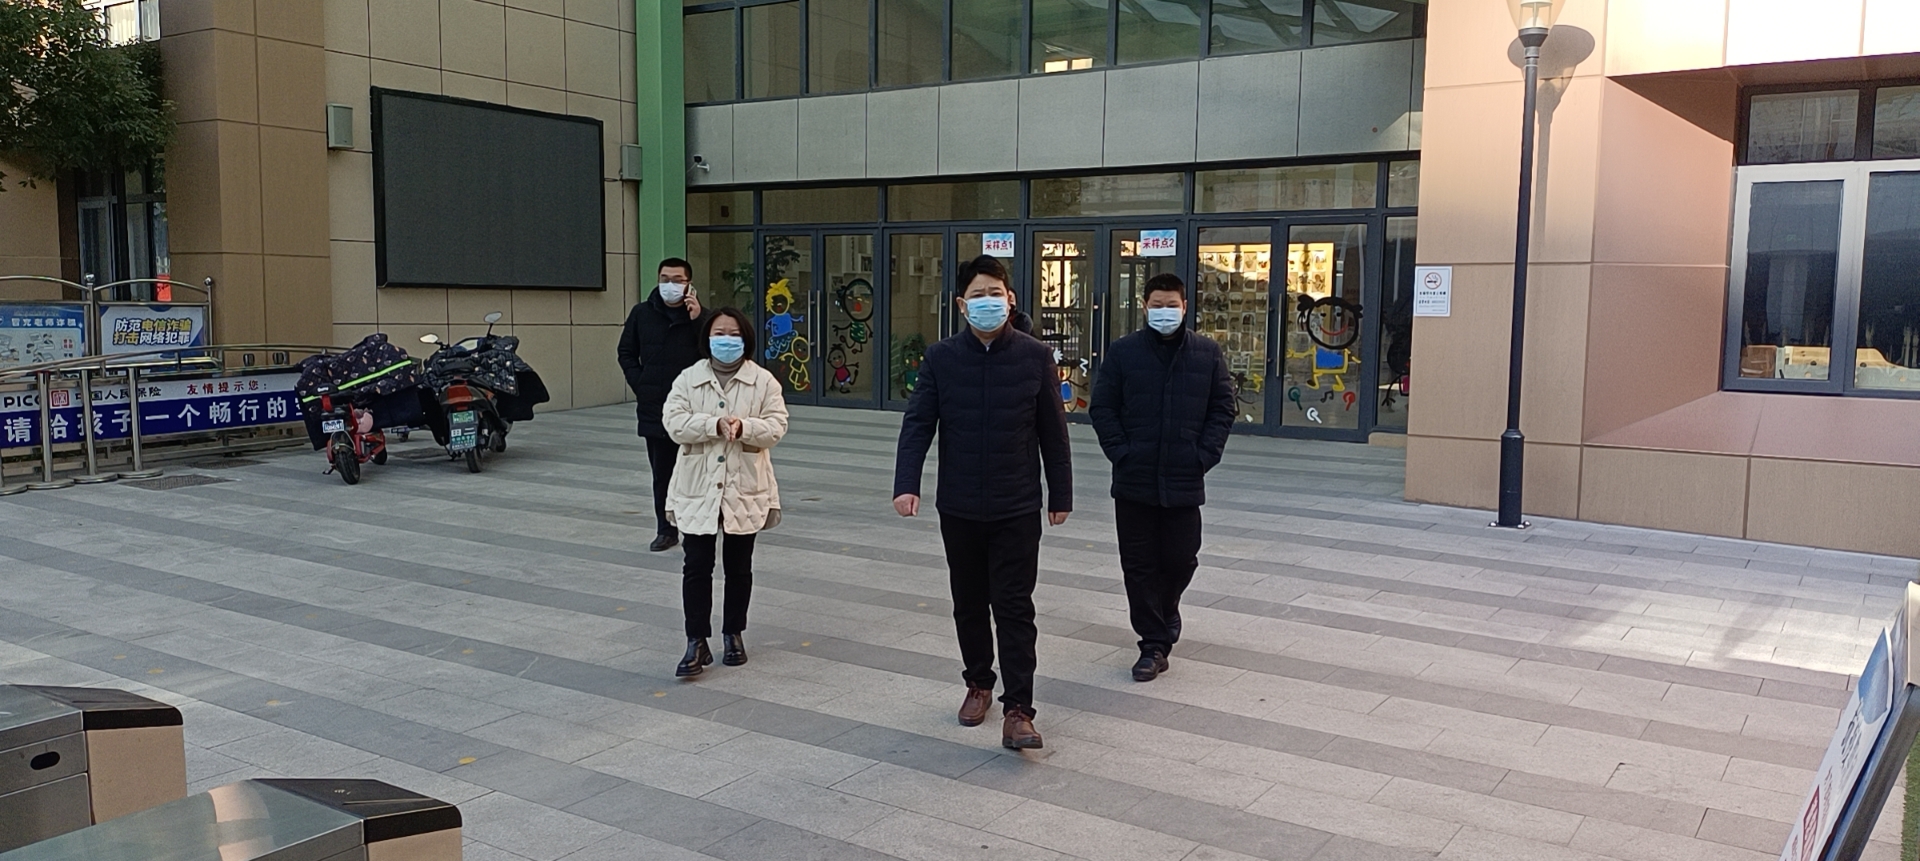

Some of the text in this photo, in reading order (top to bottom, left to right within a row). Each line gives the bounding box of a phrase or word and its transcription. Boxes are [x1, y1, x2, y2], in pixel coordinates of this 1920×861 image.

[985, 239, 1013, 251] 采样点1
[1143, 237, 1175, 249] 采样点2
[114, 318, 192, 332] 防范电信诈骗
[113, 331, 191, 345] 打击网络犯罪
